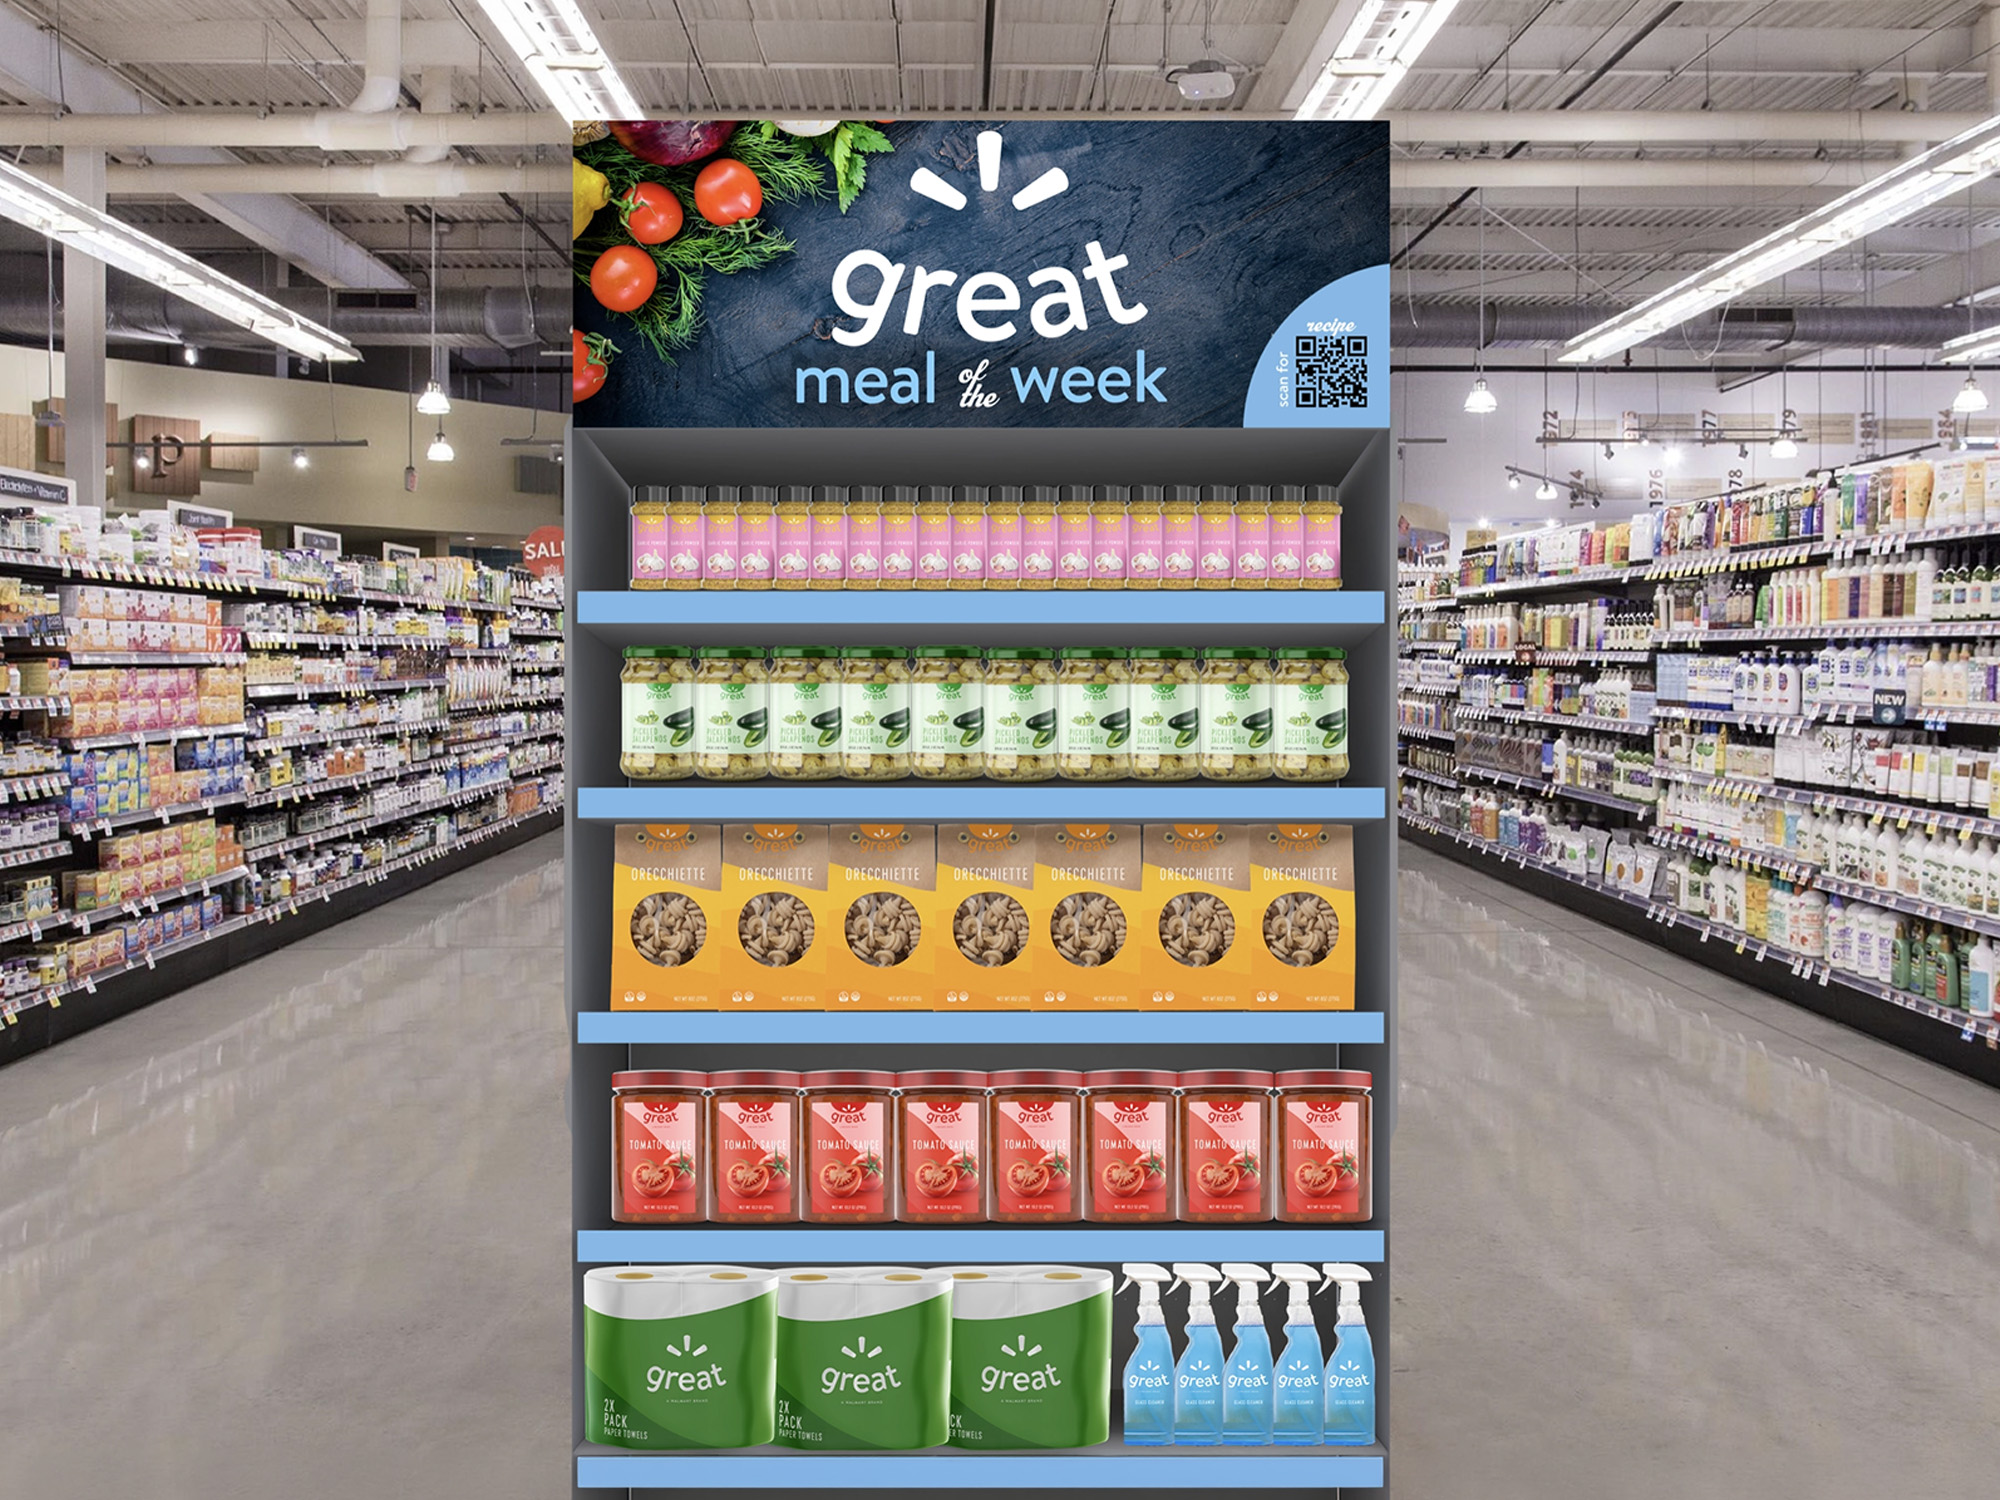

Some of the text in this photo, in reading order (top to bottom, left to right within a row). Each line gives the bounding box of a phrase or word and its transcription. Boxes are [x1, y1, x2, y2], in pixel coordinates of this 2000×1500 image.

[831, 240, 1148, 347] great
[1306, 318, 1357, 337] recipe
[796, 349, 1168, 408] meal of the week
[1276, 351, 1289, 408] scan for
[1649, 468, 1664, 508] 1976
[646, 691, 672, 700] great
[720, 692, 746, 701] great
[794, 691, 820, 700] great
[862, 692, 888, 701] great
[936, 691, 962, 700] great
[1008, 693, 1034, 702] great
[1082, 692, 1108, 701] great
[1151, 692, 1177, 701] great
[1225, 692, 1251, 701] great
[1298, 693, 1324, 702] great
[1874, 694, 1905, 706] NEW
[645, 838, 688, 854] great
[753, 838, 796, 854] great
[859, 838, 902, 854] great
[968, 838, 1012, 854] great
[1065, 838, 1108, 854] great
[1173, 838, 1216, 854] great
[1277, 838, 1320, 854] great
[631, 867, 705, 881] ORECCHIETTE
[739, 867, 813, 881] ORECCHIETTE
[845, 867, 919, 881] ORECCHIETTE
[954, 867, 1028, 881] ORECCHIETTE
[1051, 867, 1125, 881] ORECCHIETTE
[1159, 867, 1233, 881] ORECCHIETTE
[1263, 867, 1337, 881] ORECCHIETTE
[643, 1111, 679, 1124] great
[738, 1111, 774, 1124] great
[831, 1111, 867, 1124] great
[926, 1111, 962, 1124] great
[1018, 1111, 1054, 1124] great
[1113, 1110, 1149, 1123] great
[1208, 1111, 1244, 1124] great
[1306, 1111, 1342, 1124] great
[629, 1139, 662, 1150] TOMATO
[724, 1139, 757, 1150] TOMATO
[817, 1139, 850, 1150] TOMATO
[912, 1139, 945, 1150] TOMATO
[1004, 1139, 1037, 1150] TOMATO
[1099, 1138, 1132, 1149] TOMATO
[1194, 1139, 1227, 1150] TOMATO
[1292, 1139, 1325, 1150] TOMATO
[646, 1363, 726, 1392] great
[821, 1364, 901, 1394] great
[981, 1363, 1061, 1392] great
[1129, 1374, 1170, 1388] great
[1179, 1374, 1220, 1388] great
[1228, 1374, 1269, 1388] great
[1278, 1374, 1319, 1388] great
[1329, 1374, 1370, 1388] great
[604, 1398, 615, 1412] 2X
[779, 1400, 790, 1414] 2X
[604, 1412, 628, 1428] PACK
[779, 1414, 802, 1430] PACK
[950, 1414, 962, 1428] CK
[604, 1426, 648, 1440] PAPER TOWELS
[779, 1428, 822, 1441] PAPER TOWELS
[958, 1430, 983, 1440] TOWELS
